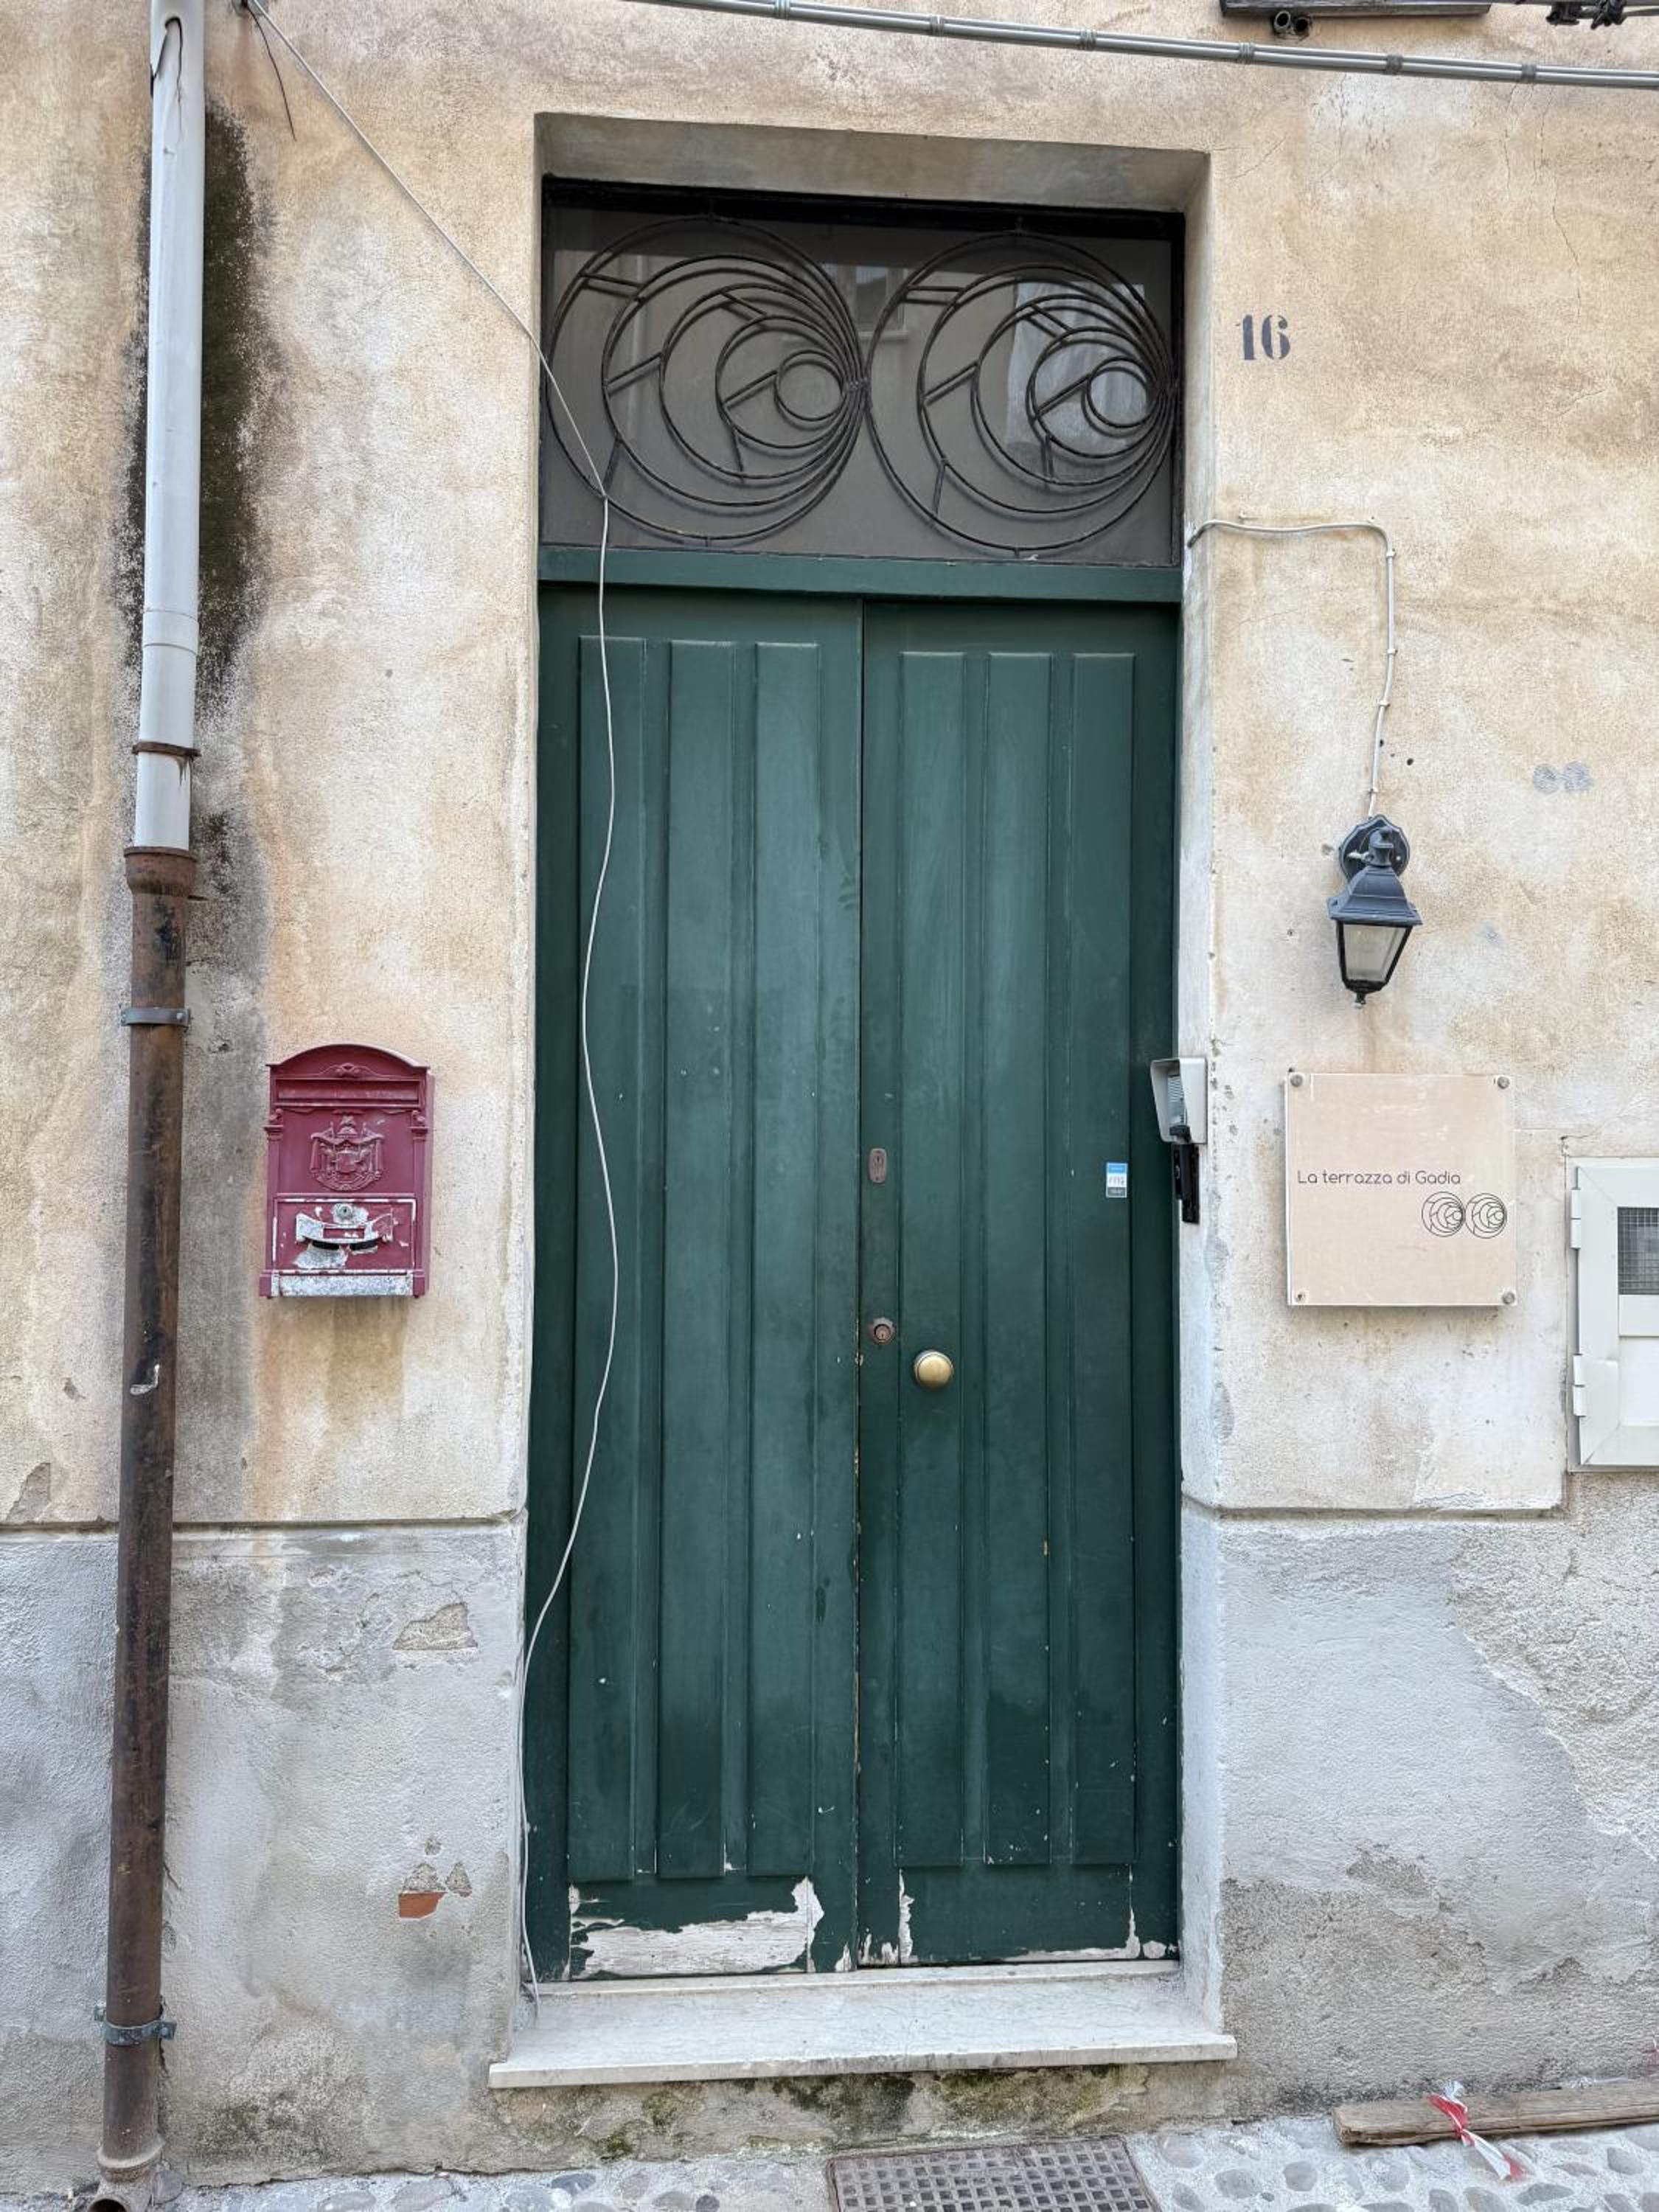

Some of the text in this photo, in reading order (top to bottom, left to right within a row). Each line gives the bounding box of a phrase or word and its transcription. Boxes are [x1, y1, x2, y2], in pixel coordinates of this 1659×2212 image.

[1235, 314, 1291, 361] 16
[1297, 1169, 1461, 1185] La terrazza di Gadia
